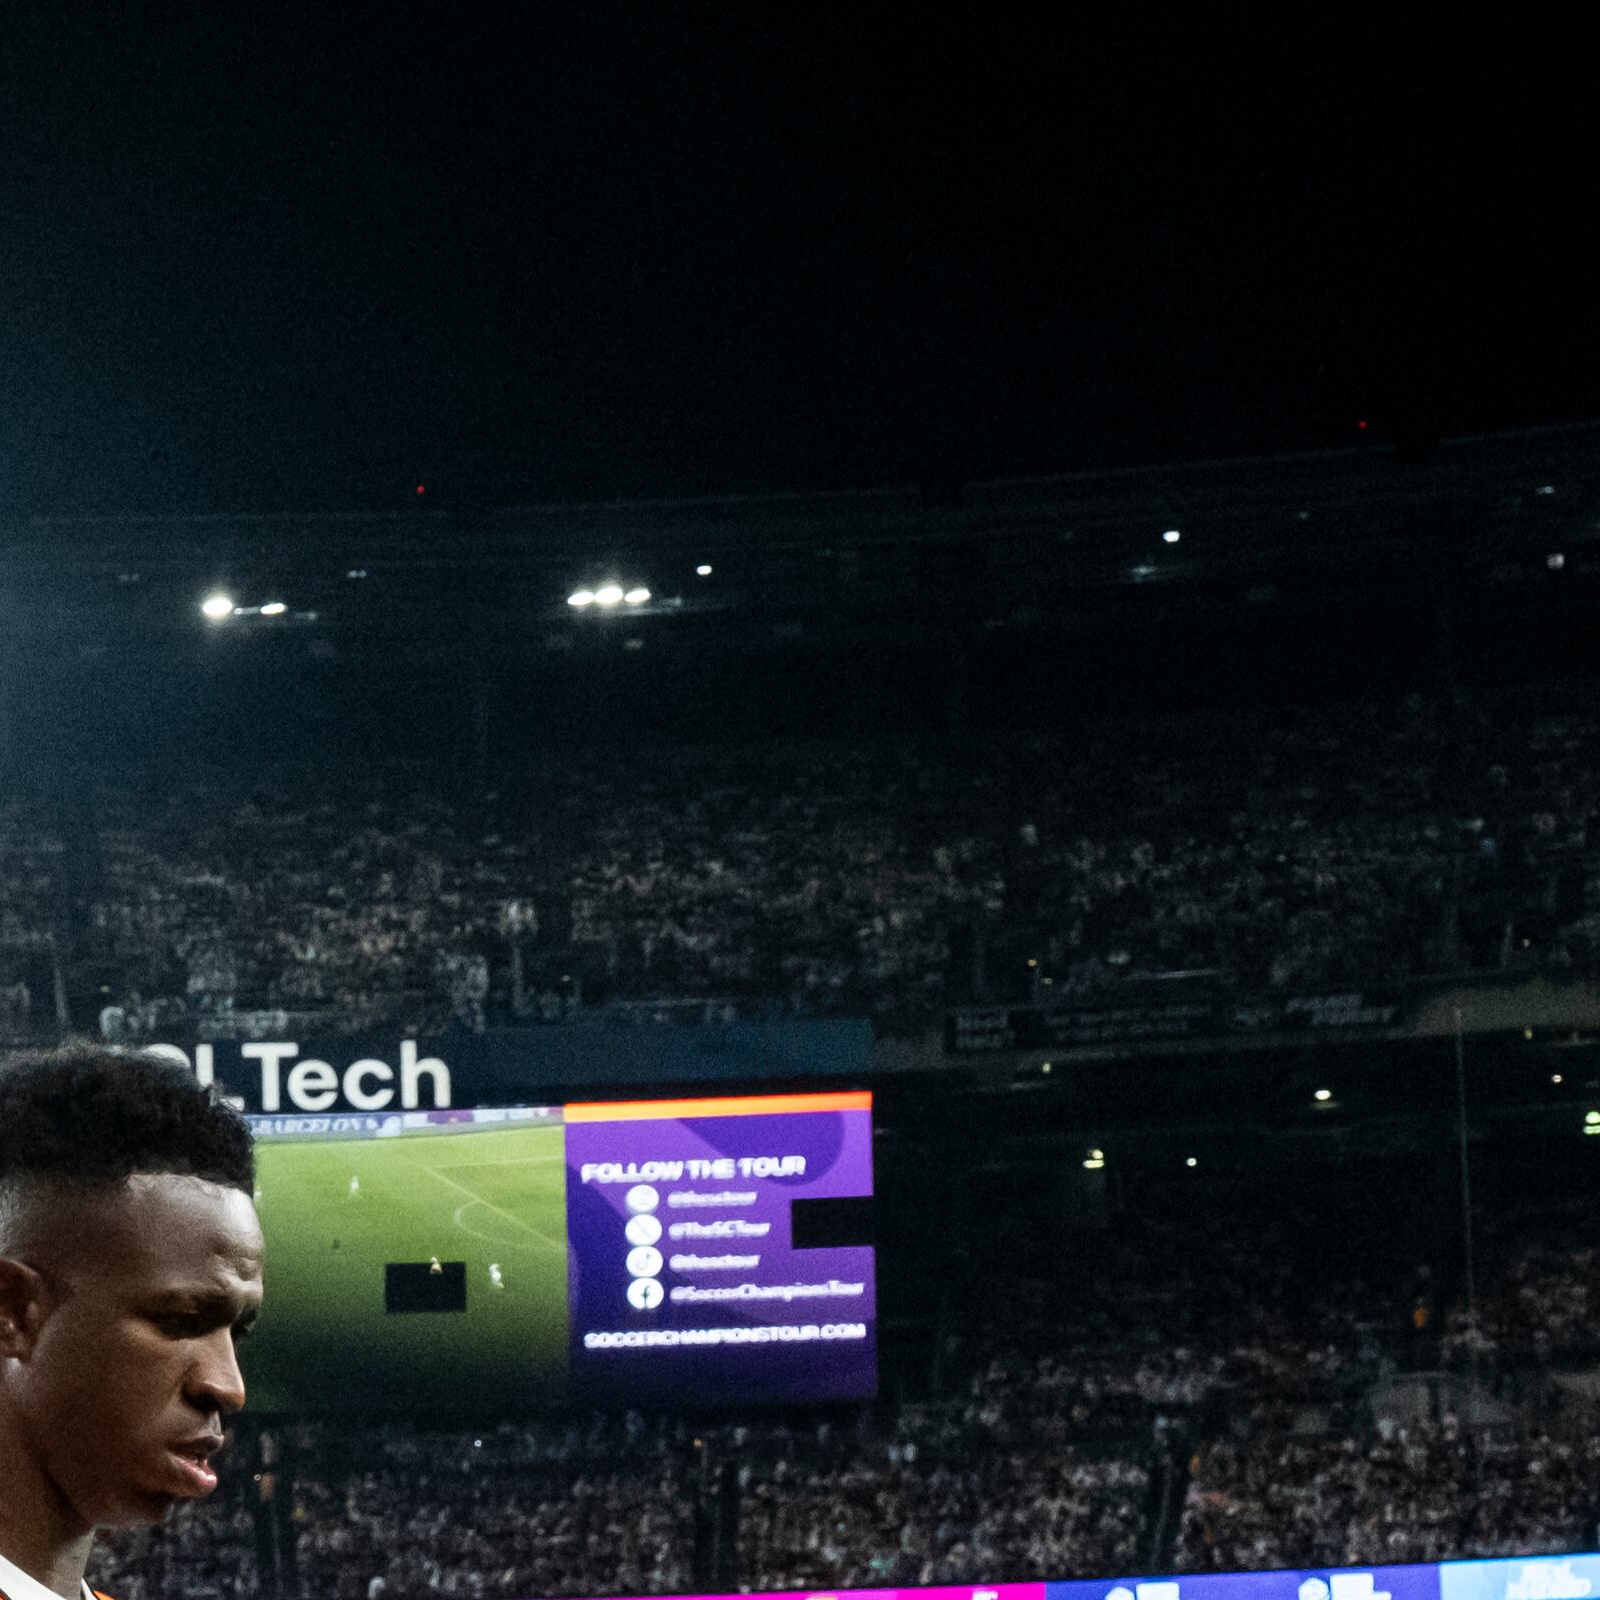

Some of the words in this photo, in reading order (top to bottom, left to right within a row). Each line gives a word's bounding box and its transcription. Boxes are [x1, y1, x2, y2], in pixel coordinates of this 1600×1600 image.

[581, 1161, 684, 1183] FOLLOW
[686, 1158, 735, 1180] THE
[737, 1156, 806, 1178] TOUR
